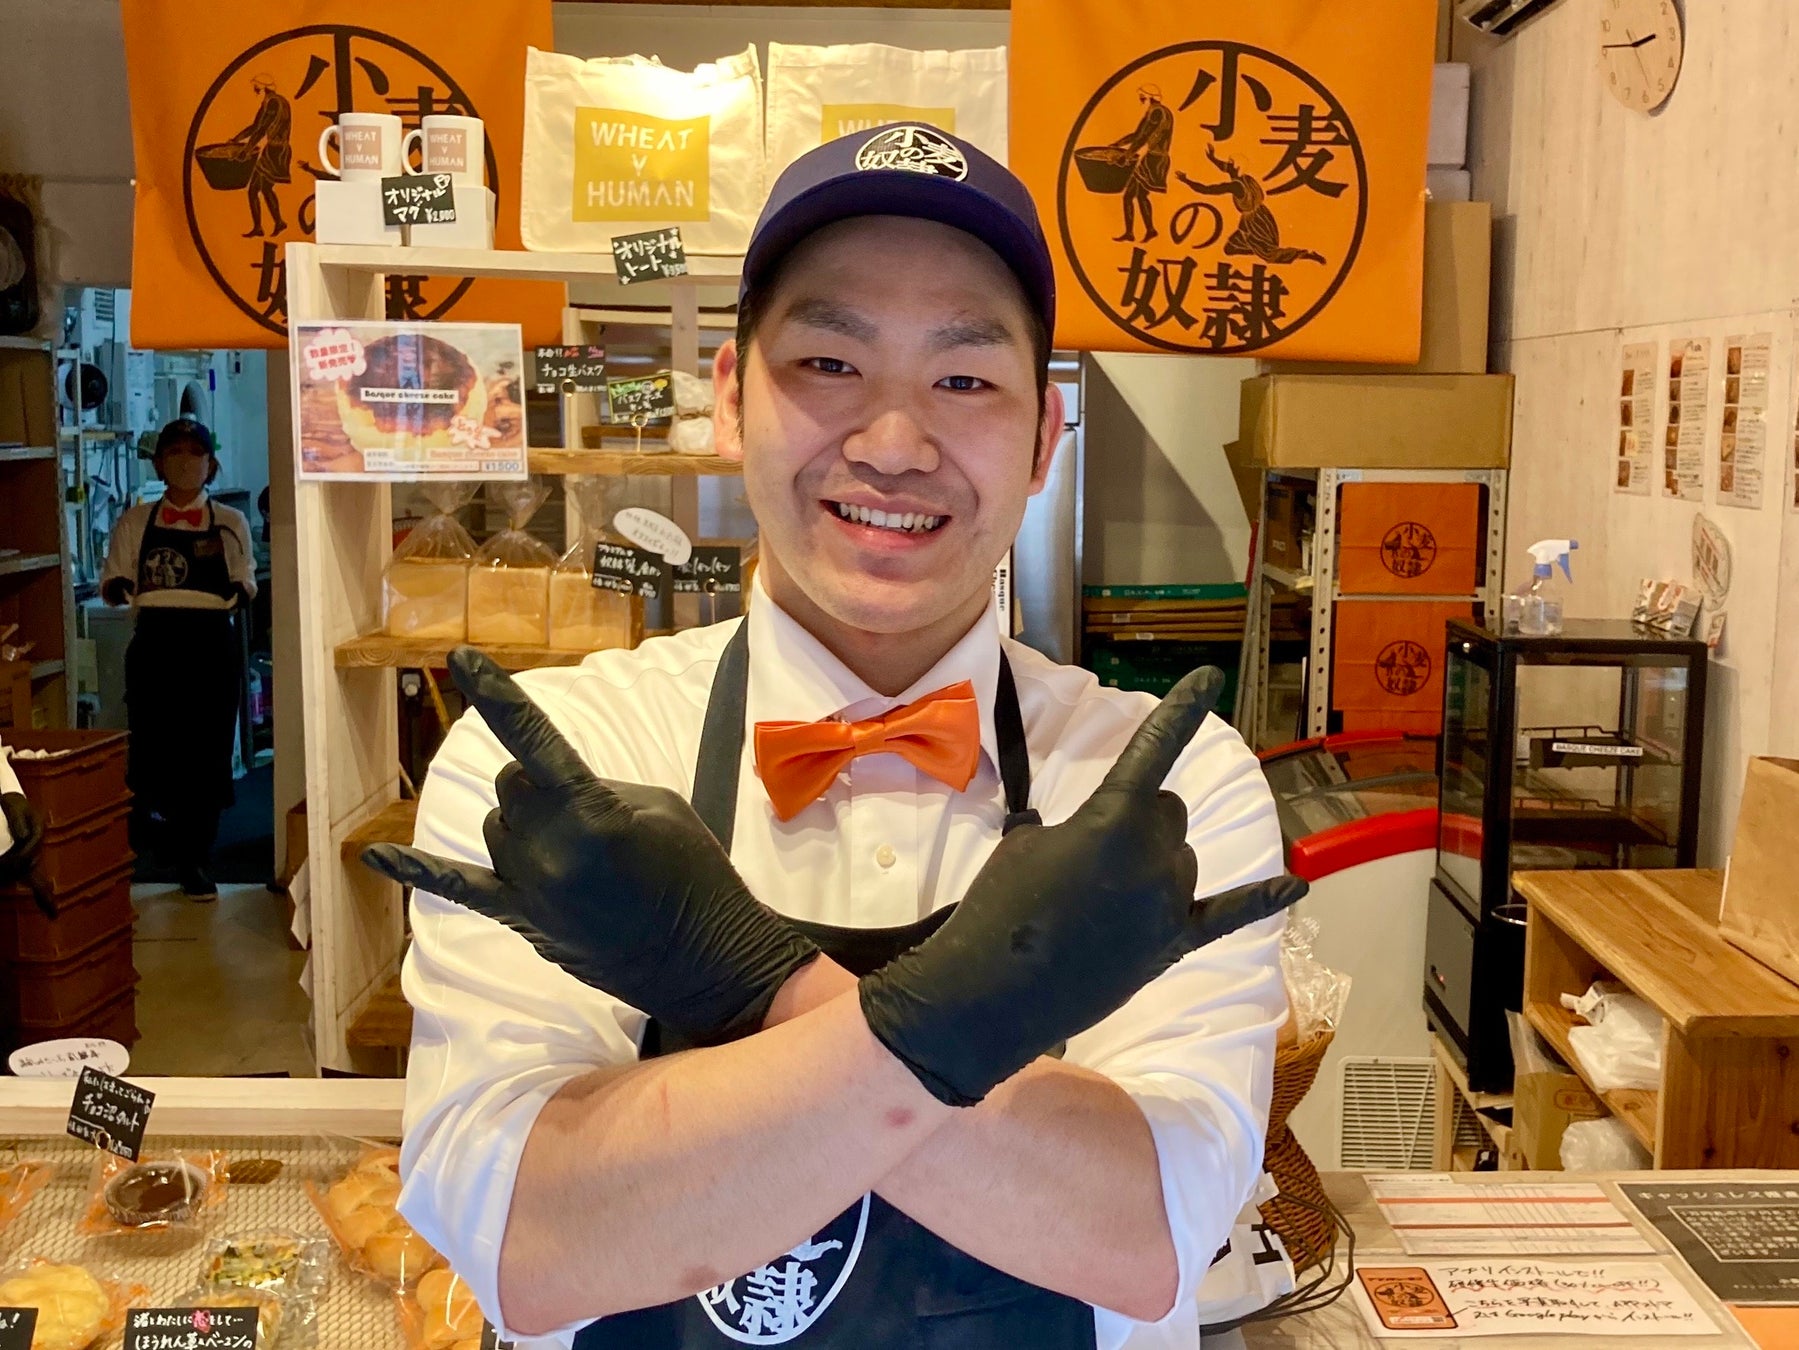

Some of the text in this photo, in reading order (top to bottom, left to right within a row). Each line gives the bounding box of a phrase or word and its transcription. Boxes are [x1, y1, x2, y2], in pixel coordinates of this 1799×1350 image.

[344, 131, 377, 142] WHEAT
[428, 133, 463, 144] WHEAT
[590, 121, 695, 151] WHEAT
[344, 154, 379, 165] HUMAN
[428, 156, 465, 167] HUMAN
[384, 186, 447, 206] オリジナル
[587, 179, 694, 208] HUMAN
[393, 200, 424, 223] マグ
[615, 233, 683, 260] オリジナル
[624, 254, 663, 277] トート
[364, 390, 455, 400] Basque cheese cake
